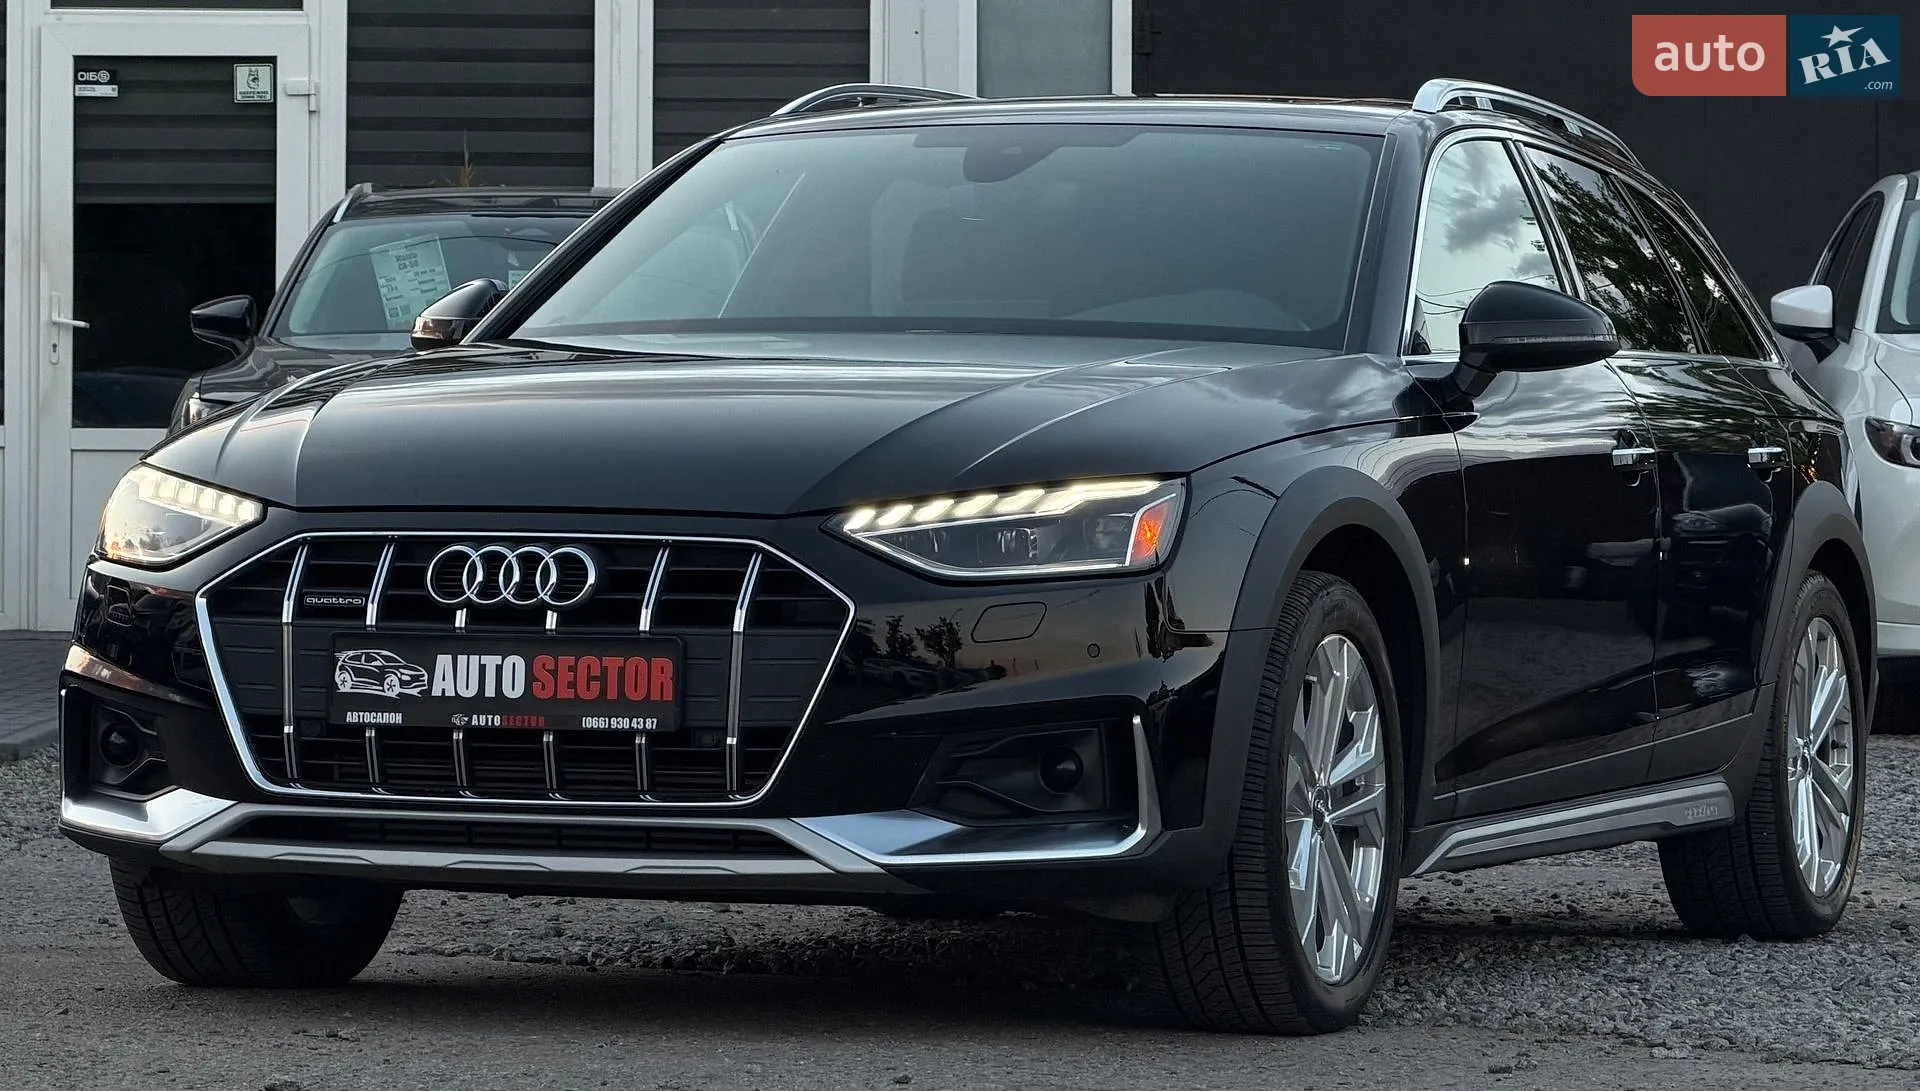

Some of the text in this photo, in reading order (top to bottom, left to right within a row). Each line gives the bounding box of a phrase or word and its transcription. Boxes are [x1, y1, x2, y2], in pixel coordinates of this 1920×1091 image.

[305, 597, 363, 605] quattro
[431, 654, 674, 701] AUTO SECTOR
[345, 711, 403, 724] АВТОСАЛОН
[582, 716, 658, 730] (066) 930 43 87
